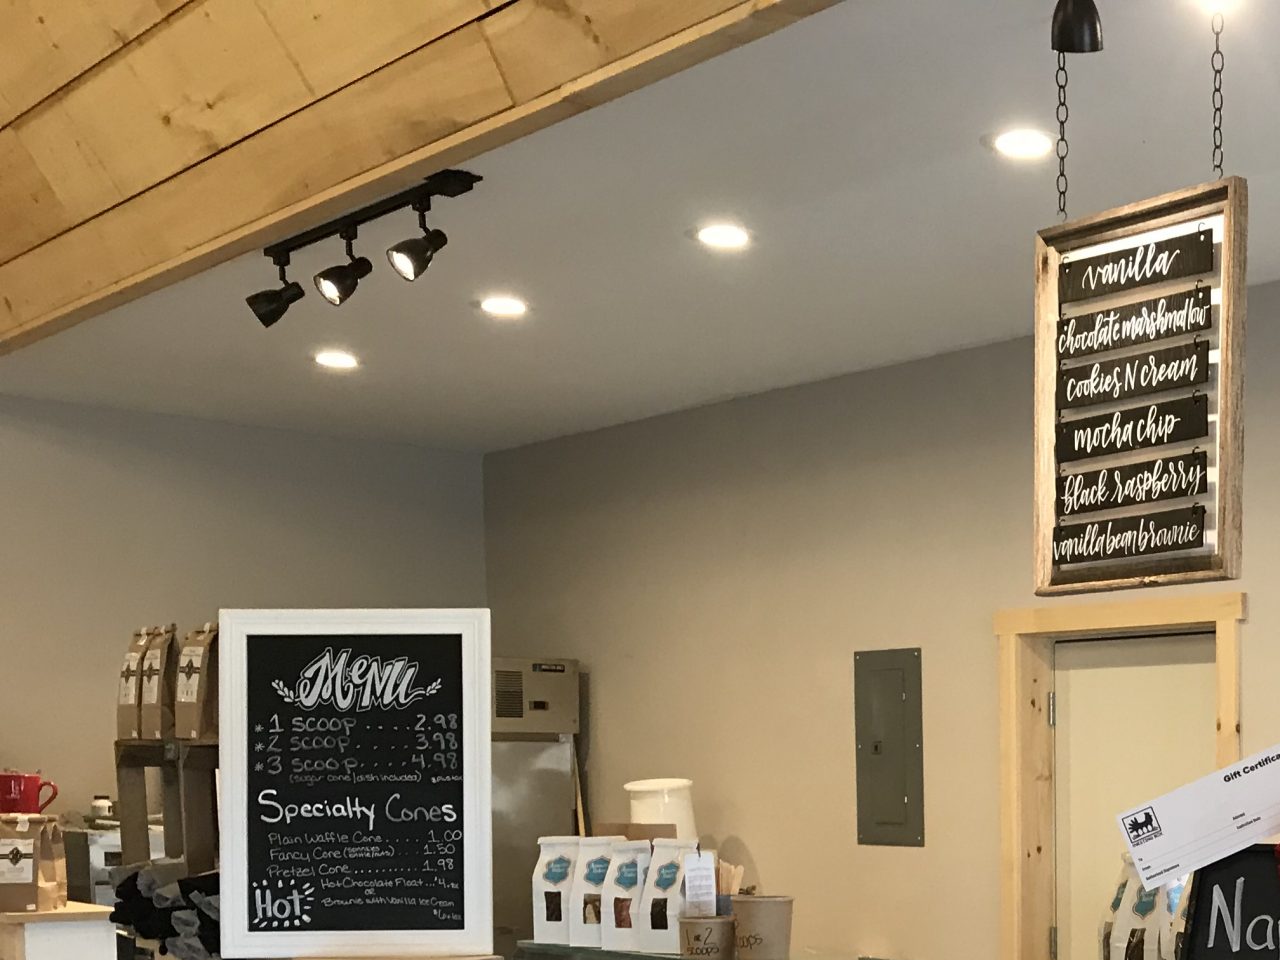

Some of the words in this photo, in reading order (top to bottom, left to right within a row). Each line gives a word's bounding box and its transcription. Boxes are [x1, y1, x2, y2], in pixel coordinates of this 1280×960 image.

[1082, 242, 1180, 290] vanilla
[1059, 310, 1120, 355] chocolate
[1122, 296, 1210, 340] marshmallow
[1066, 363, 1122, 401] cookies
[1124, 359, 1139, 392] N
[1141, 354, 1198, 387] cream
[1074, 411, 1134, 453] mocha
[1137, 405, 1181, 444] chip
[1061, 469, 1109, 514] black
[1111, 459, 1206, 503] raspberry
[1053, 523, 1105, 562] vanilla
[1106, 521, 1137, 555] bean
[1138, 518, 1200, 552] brownie
[268, 713, 284, 732] 1
[414, 713, 458, 730] 2.98
[266, 735, 282, 752] 2
[415, 732, 458, 750] 3.98
[266, 755, 282, 774] 3
[411, 752, 458, 770] 4.98
[1223, 770, 1242, 783] Gift
[258, 789, 375, 831] Specialty
[385, 793, 457, 822] Cones
[268, 832, 303, 845] Plain
[352, 831, 382, 843] Cone
[427, 829, 462, 843] 1.00
[269, 848, 311, 862] Fancy
[312, 847, 342, 860] Cone
[423, 843, 456, 855] 1.50
[266, 864, 316, 878] Pretzel
[318, 863, 351, 875] Cone
[421, 858, 455, 872] 1.98
[342, 877, 394, 888] Chocolate
[255, 889, 305, 919] Hot
